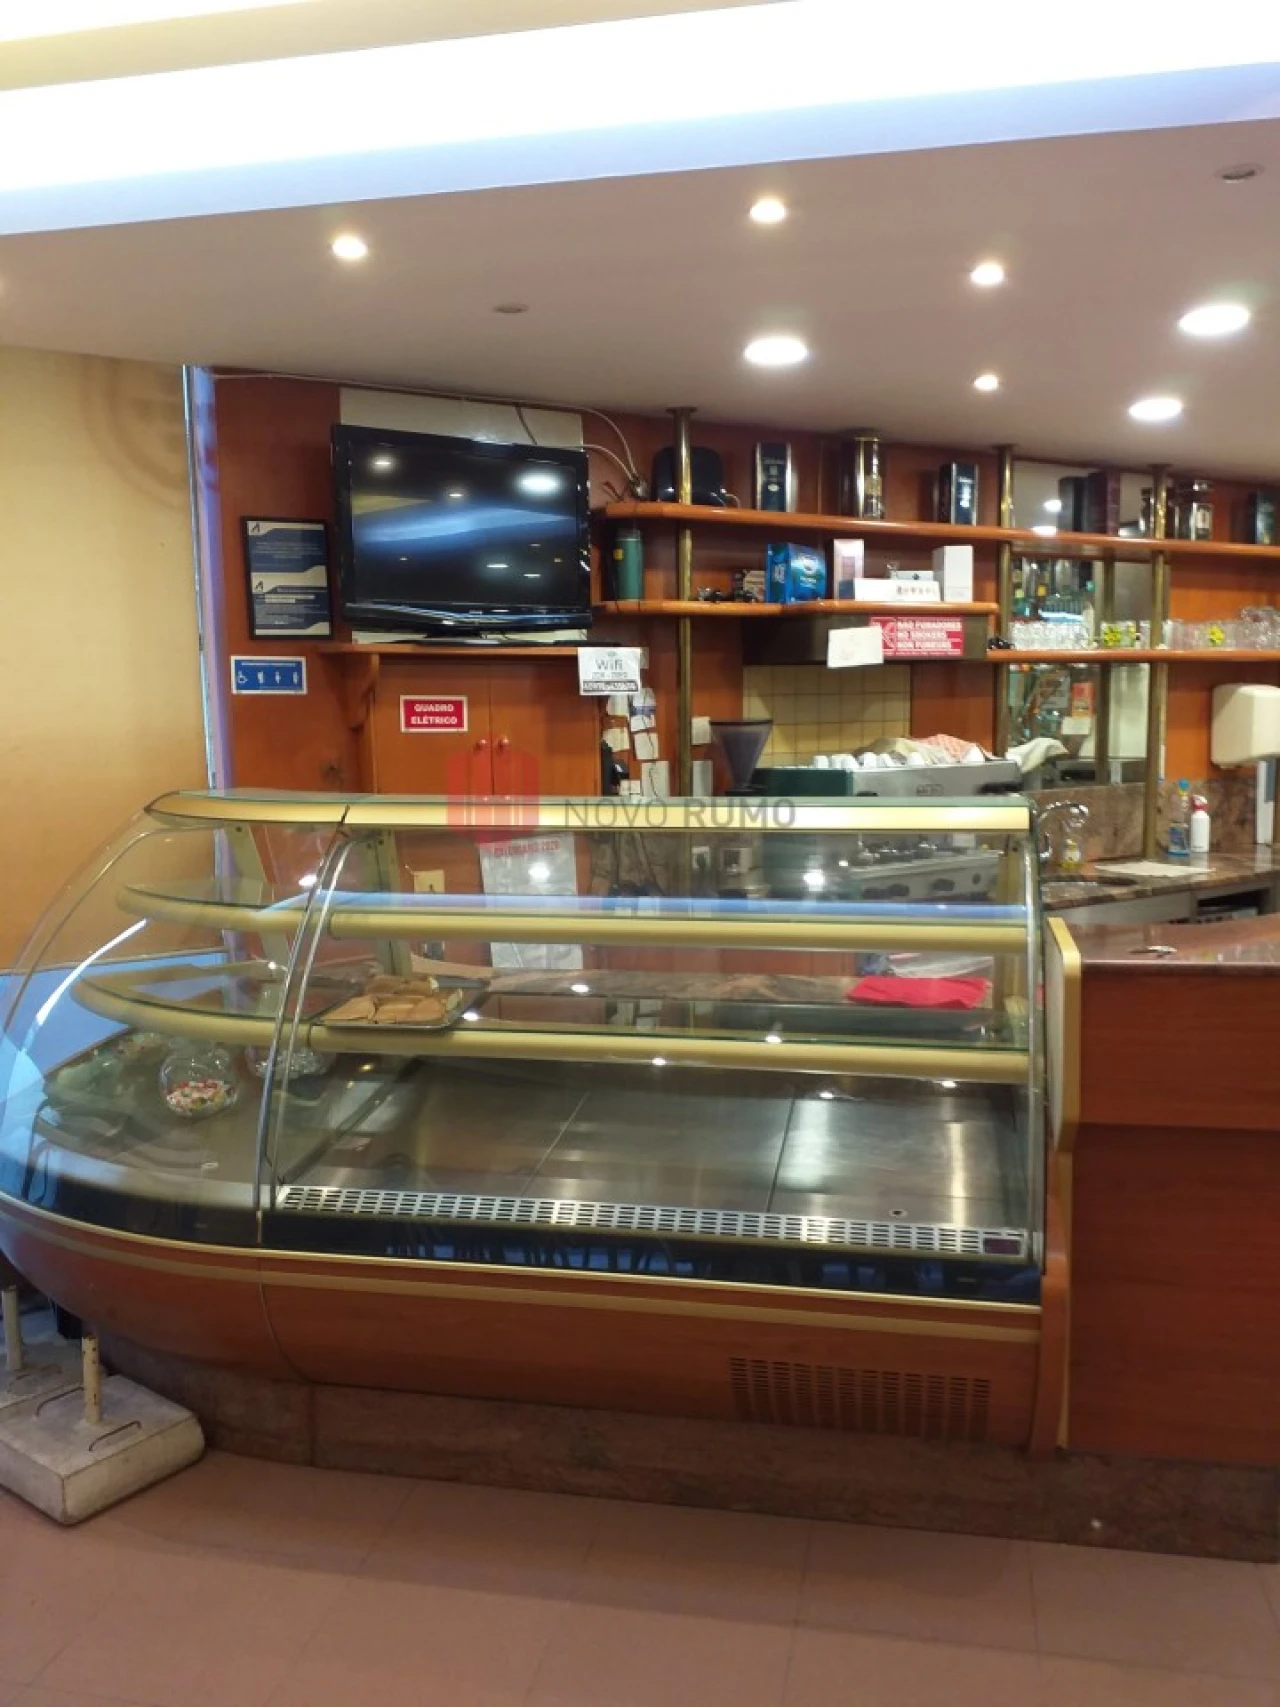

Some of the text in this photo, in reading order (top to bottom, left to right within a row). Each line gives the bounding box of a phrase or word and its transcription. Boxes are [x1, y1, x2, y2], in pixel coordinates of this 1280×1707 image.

[897, 631, 947, 640] NO SMOKERS
[413, 703, 454, 712] QUADRO
[410, 714, 458, 725] ELÉTRICO
